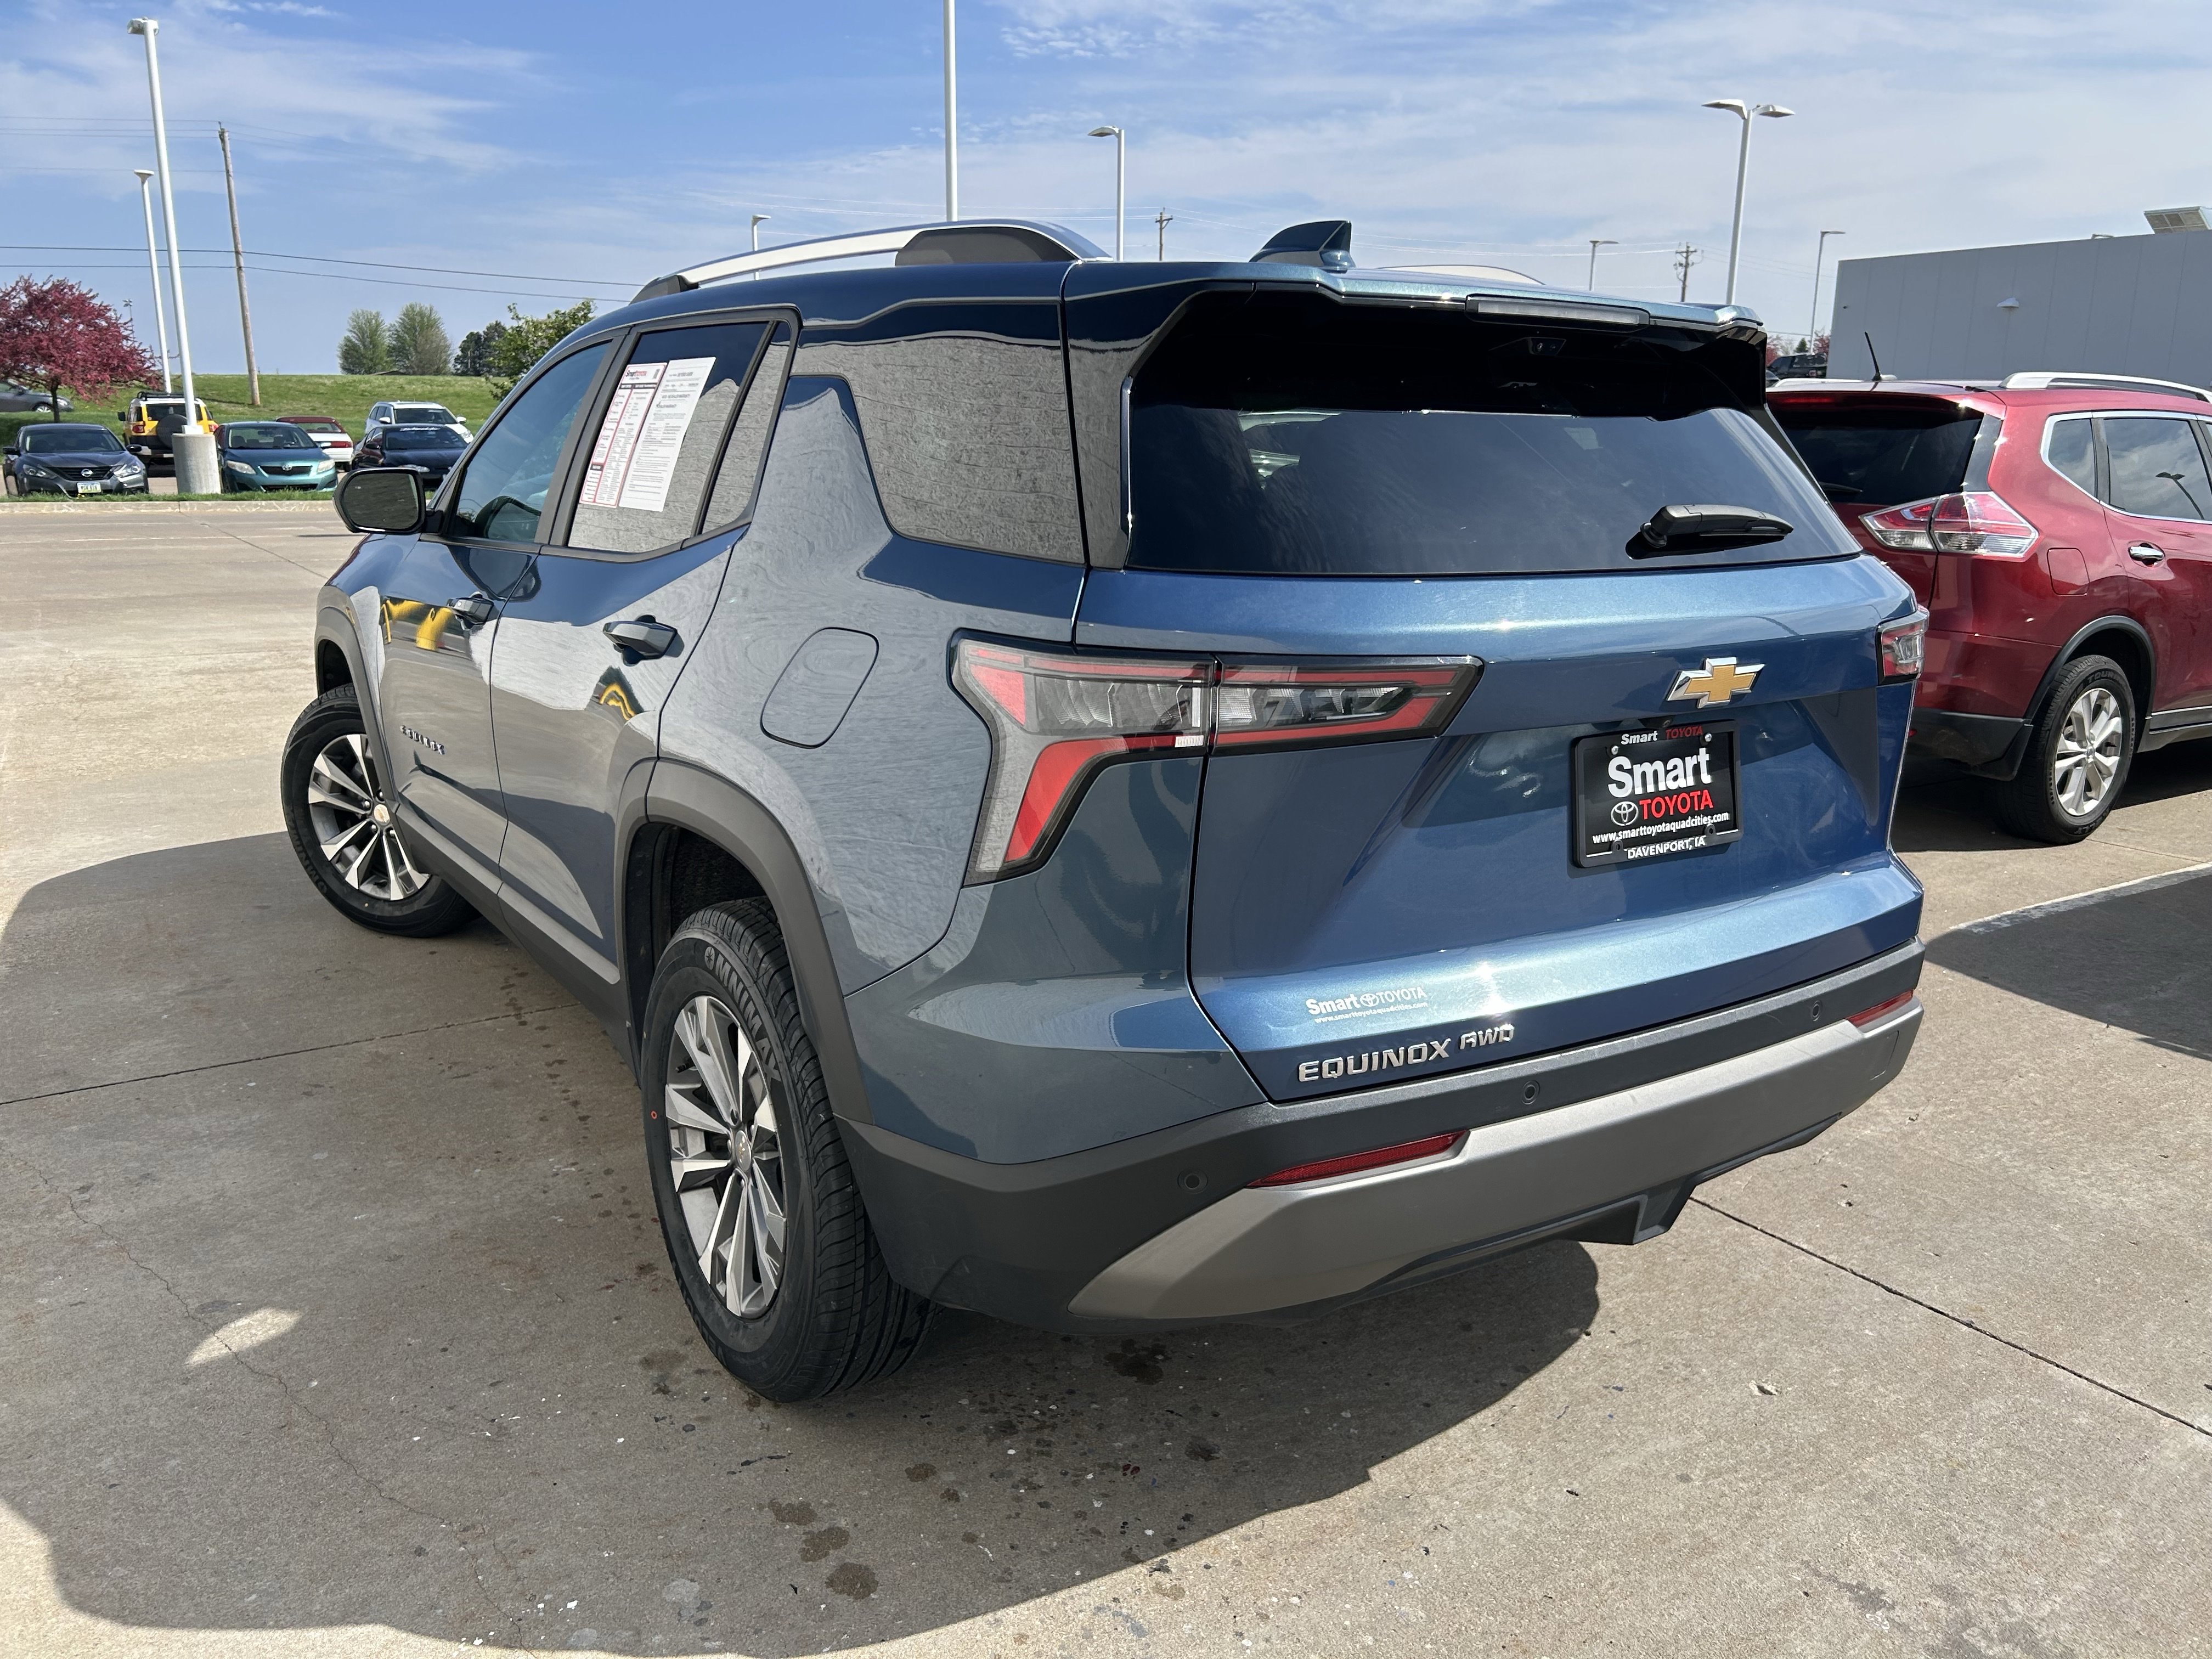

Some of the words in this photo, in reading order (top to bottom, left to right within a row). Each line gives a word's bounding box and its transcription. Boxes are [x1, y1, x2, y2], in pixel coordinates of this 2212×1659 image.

[1621, 730, 1658, 745] Smart
[1665, 726, 1703, 739] TOYOTA
[1607, 747, 1713, 798] Smart
[1639, 789, 1714, 820] TOYOTA
[1592, 811, 1730, 844] www.smarttoyotaquadcities.com
[1627, 838, 1693, 859] DAVENPORT,
[1694, 836, 1706, 847] IA
[1306, 994, 1361, 1015] Smart
[1376, 986, 1427, 1004] TOYOTA
[1314, 1002, 1428, 1024] www.smarttoyotaquadcities.com
[1298, 1038, 1452, 1082] EQUINOX
[1459, 1024, 1515, 1050] AWD
